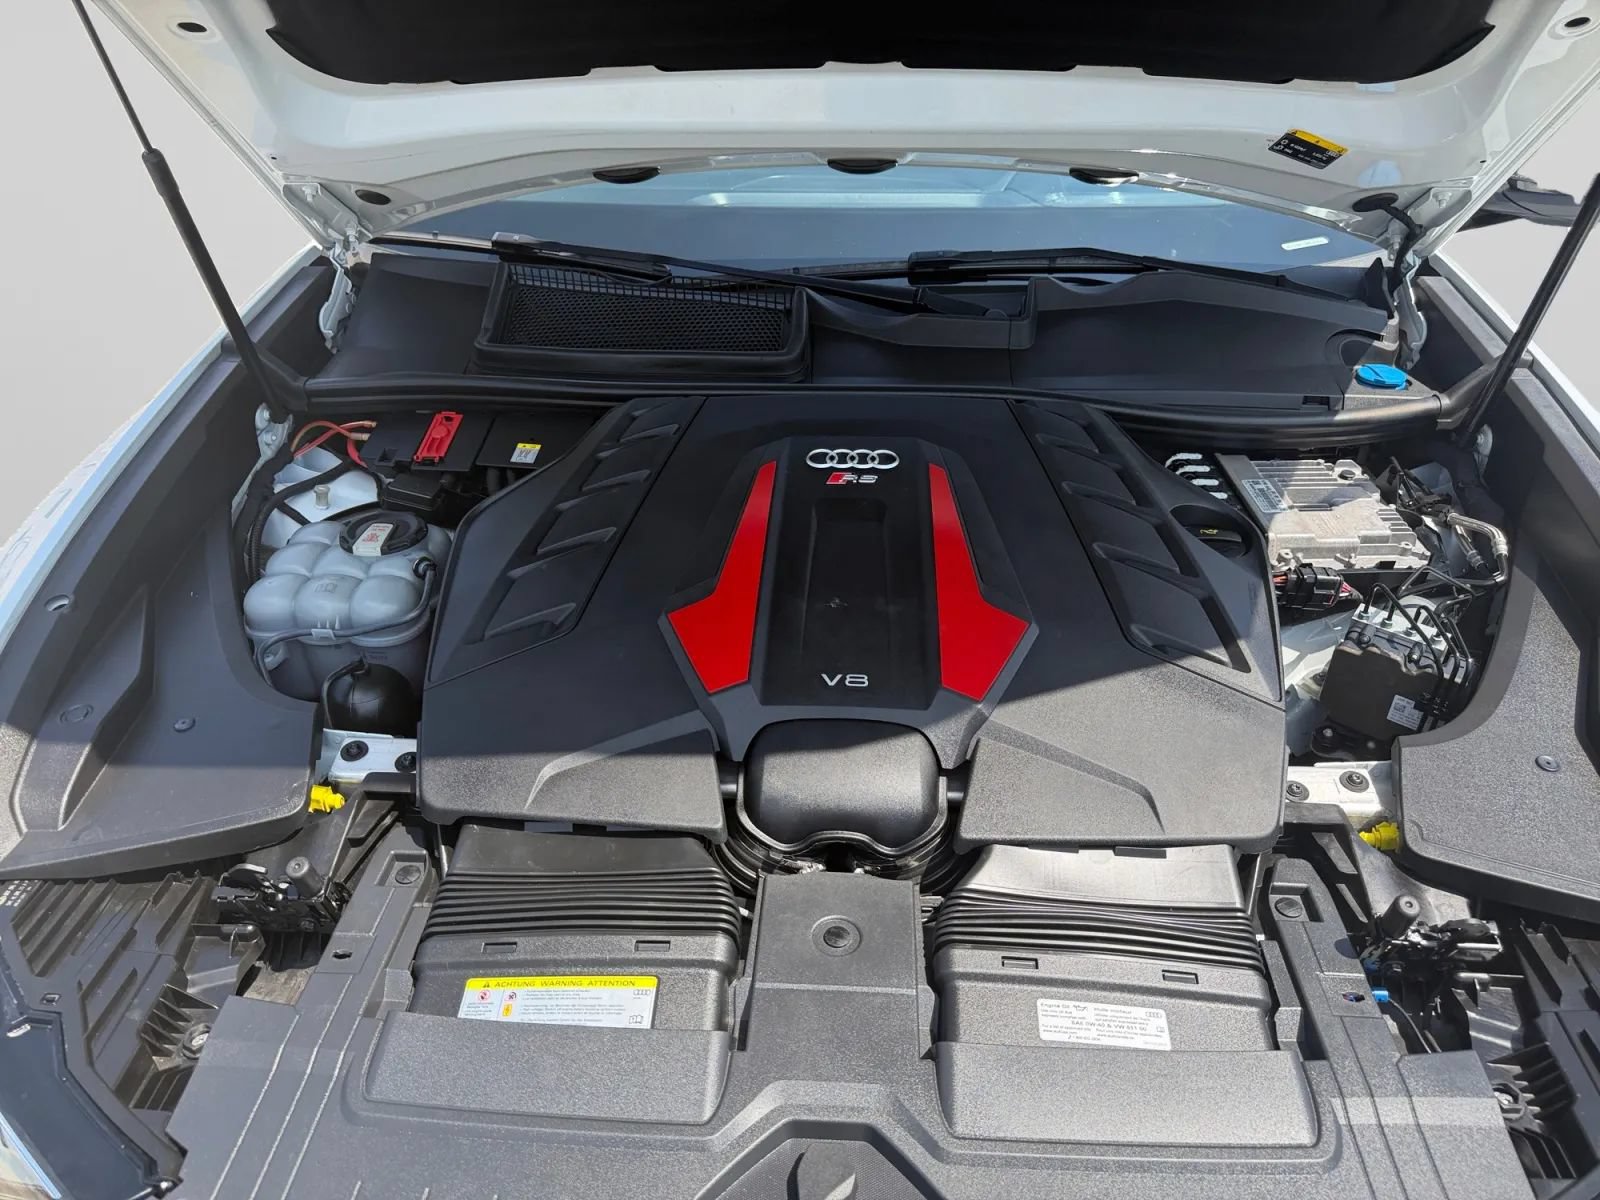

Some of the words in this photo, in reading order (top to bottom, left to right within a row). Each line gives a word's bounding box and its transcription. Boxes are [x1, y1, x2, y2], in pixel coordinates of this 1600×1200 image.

[831, 473, 878, 484] RS
[821, 673, 869, 687] V8
[494, 980, 536, 988] ACHTUNG
